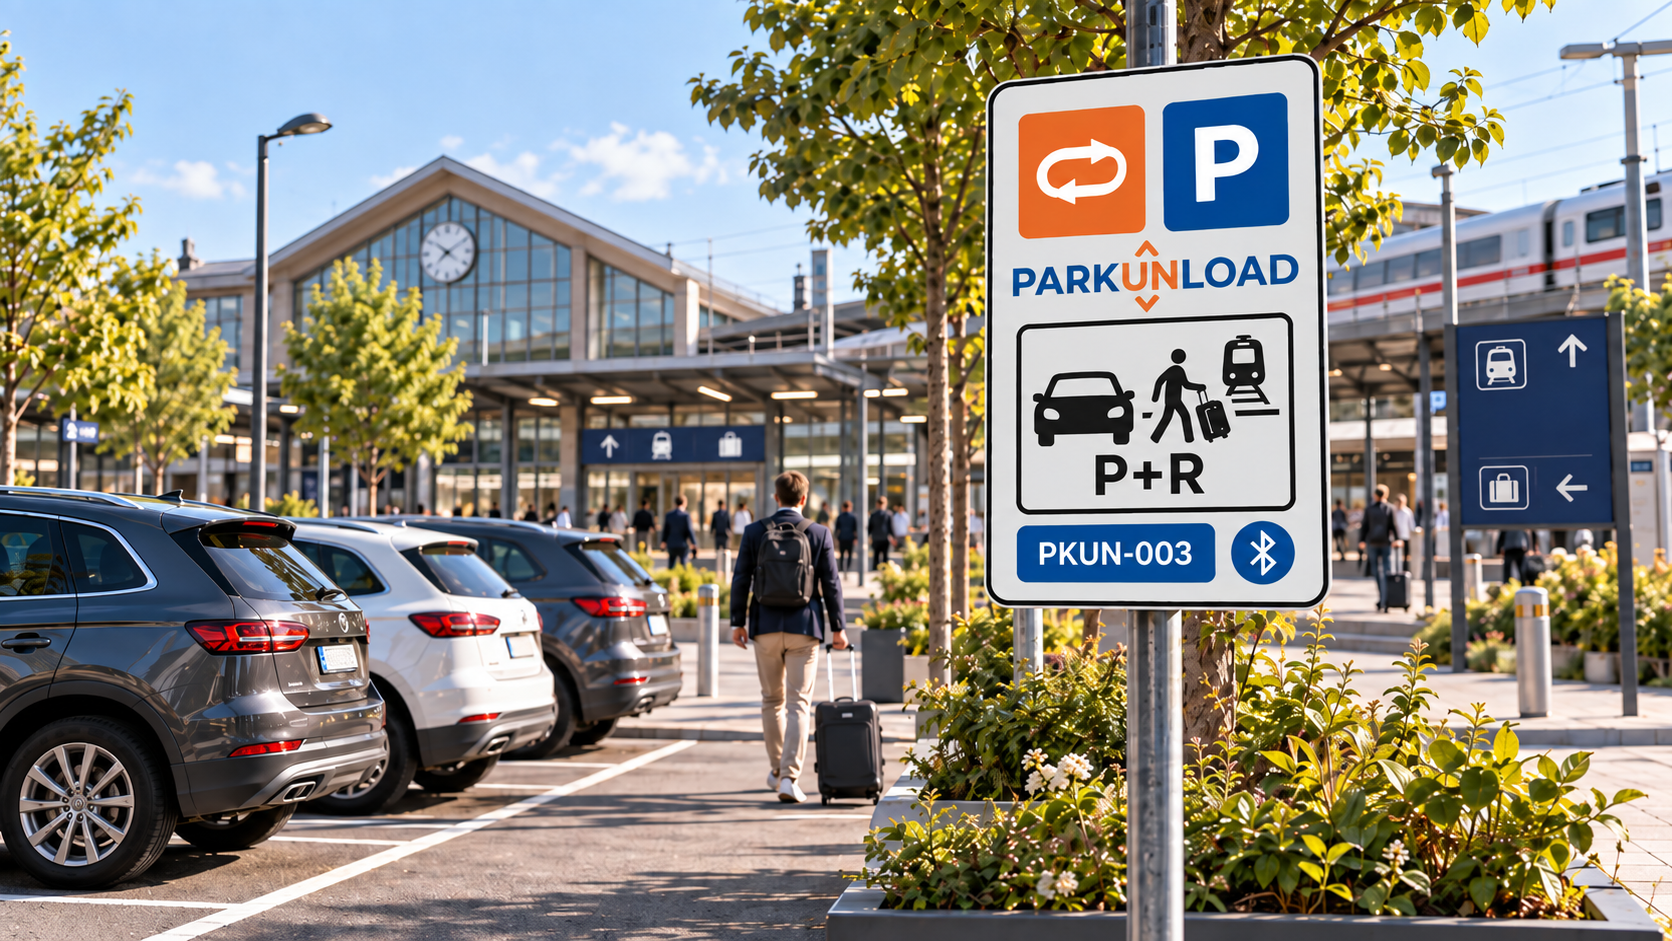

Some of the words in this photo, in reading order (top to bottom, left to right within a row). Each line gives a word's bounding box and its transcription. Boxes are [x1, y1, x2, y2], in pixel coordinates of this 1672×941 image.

[1194, 124, 1259, 203] P
[1012, 254, 1300, 297] PARKUNLOAD
[1095, 452, 1205, 496] P+R
[1039, 540, 1193, 566] PKUN-003
